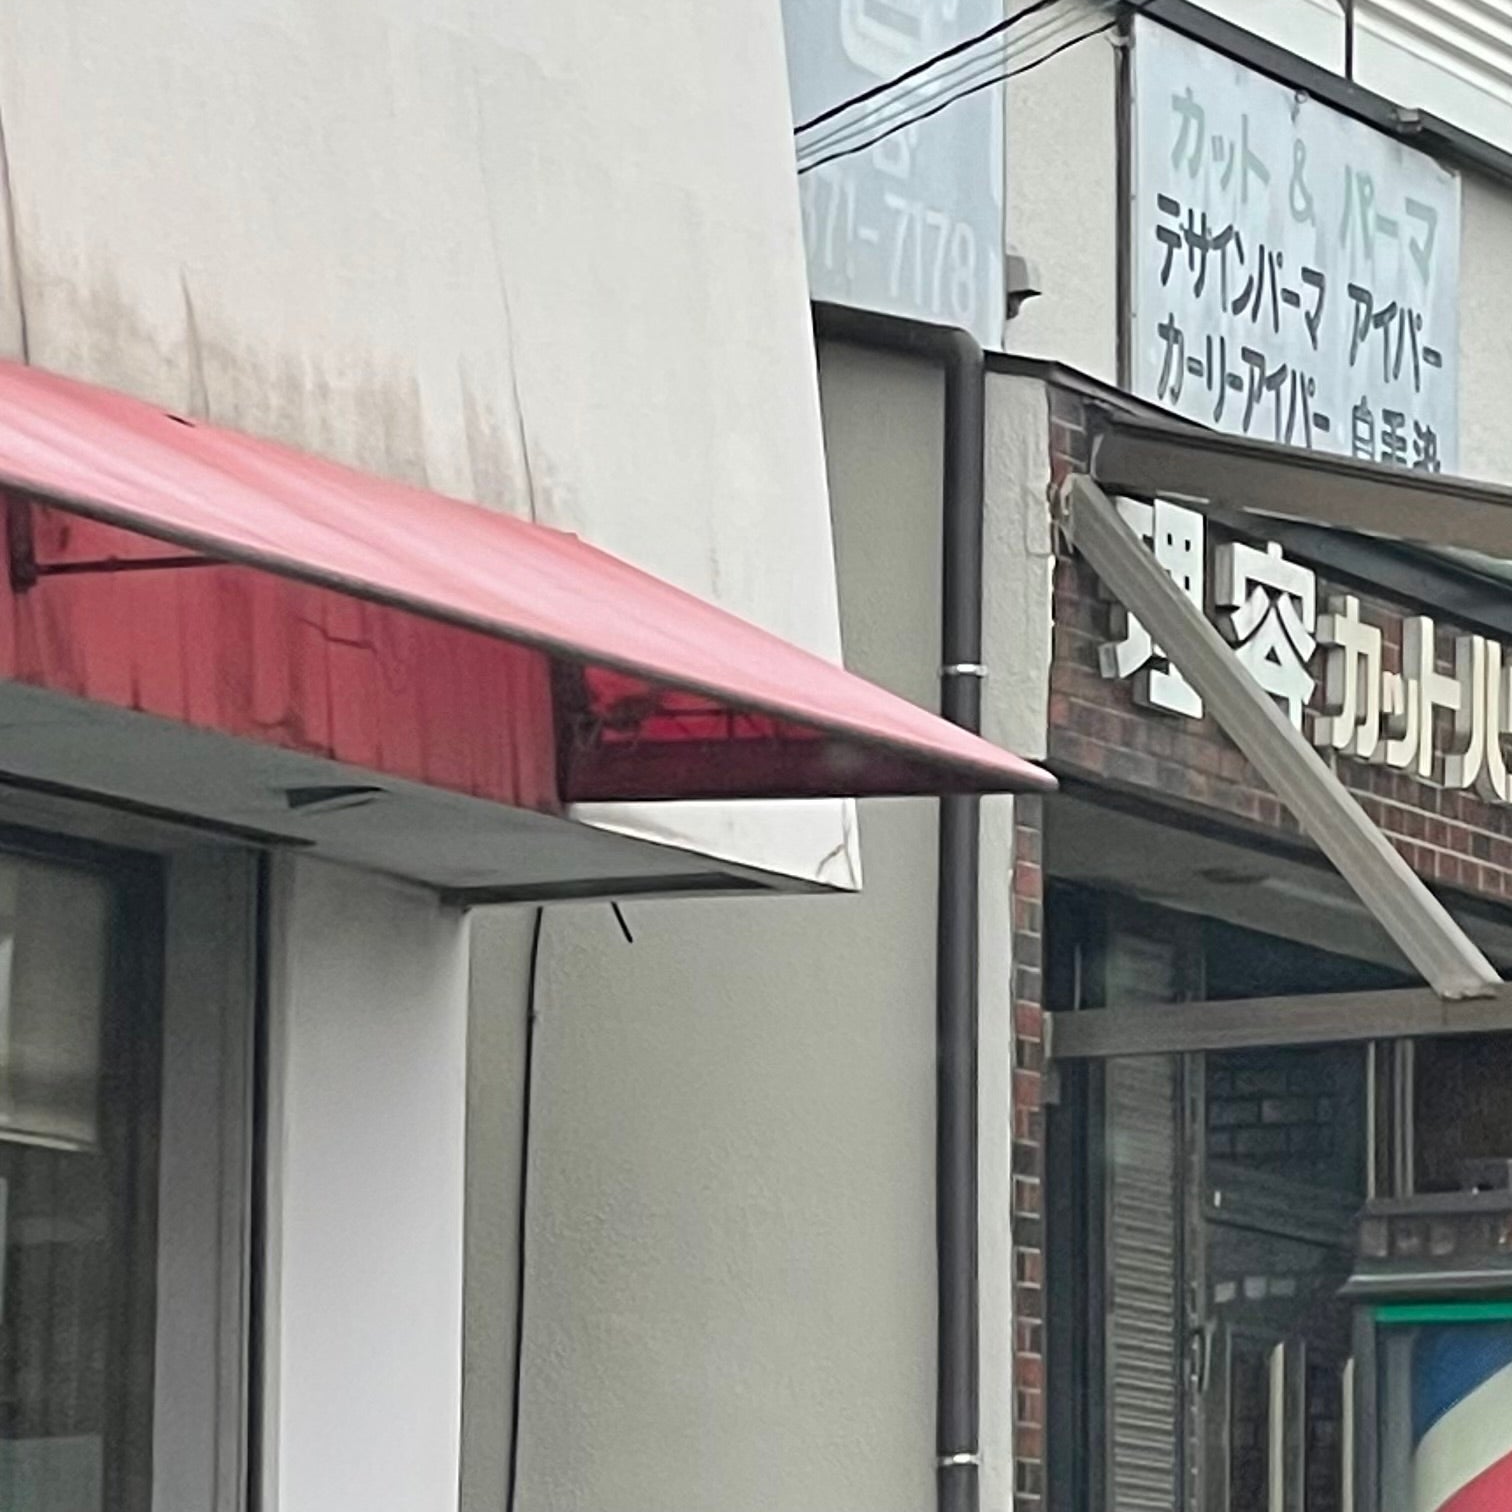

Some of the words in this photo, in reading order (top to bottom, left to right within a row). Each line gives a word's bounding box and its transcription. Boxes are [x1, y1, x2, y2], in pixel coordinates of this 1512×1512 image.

[1171, 87, 1270, 205] カット
[1290, 138, 1316, 228] &
[1340, 164, 1438, 286] パーマ
[1158, 312, 1330, 450] カーリーアイパー
[1348, 283, 1443, 393] アイパー
